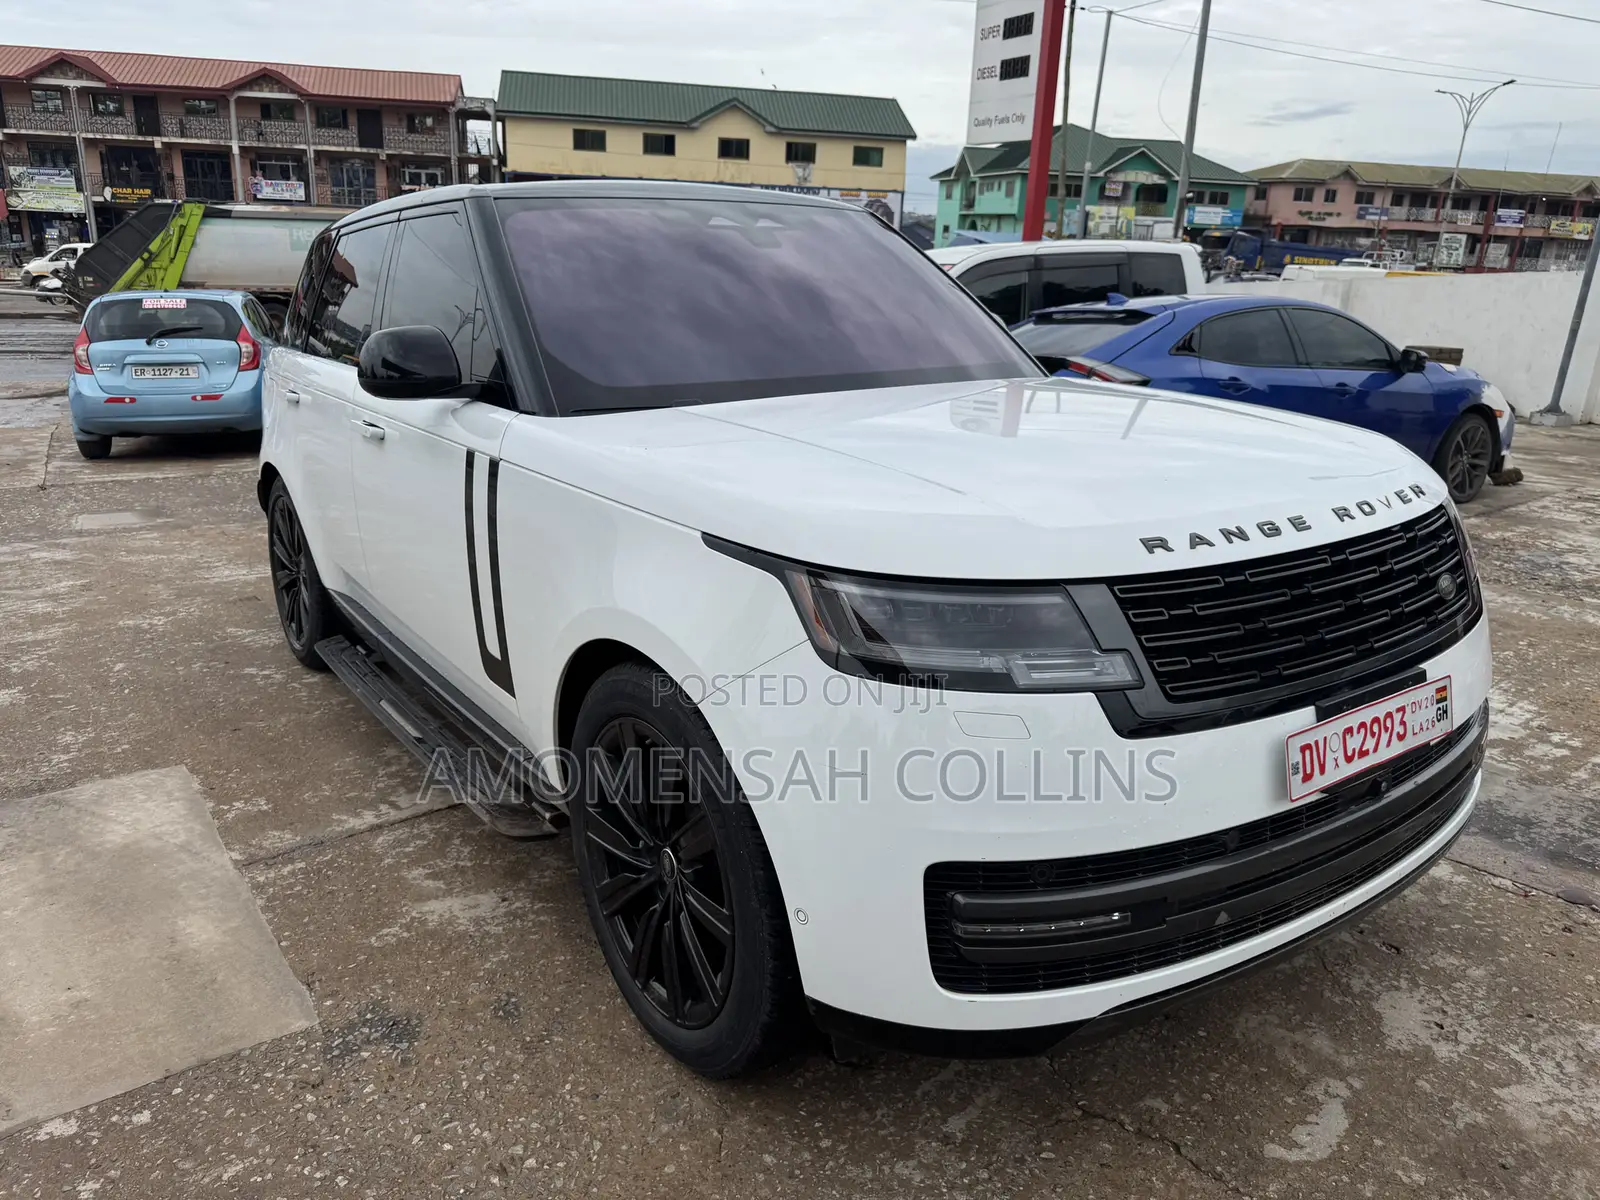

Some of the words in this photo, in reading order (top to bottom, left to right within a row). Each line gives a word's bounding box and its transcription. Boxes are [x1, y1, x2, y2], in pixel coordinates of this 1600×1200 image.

[980, 24, 1001, 41] SUPER
[976, 65, 998, 81] DIESEL
[973, 115, 993, 128] Quality
[993, 113, 1010, 125] Fuels
[1011, 112, 1026, 125] Only
[1139, 514, 1312, 555] RANGE
[1331, 483, 1428, 523] ROVER
[1435, 704, 1448, 723] GH
[1299, 735, 1327, 784] DV
[1341, 703, 1408, 764] C2993
